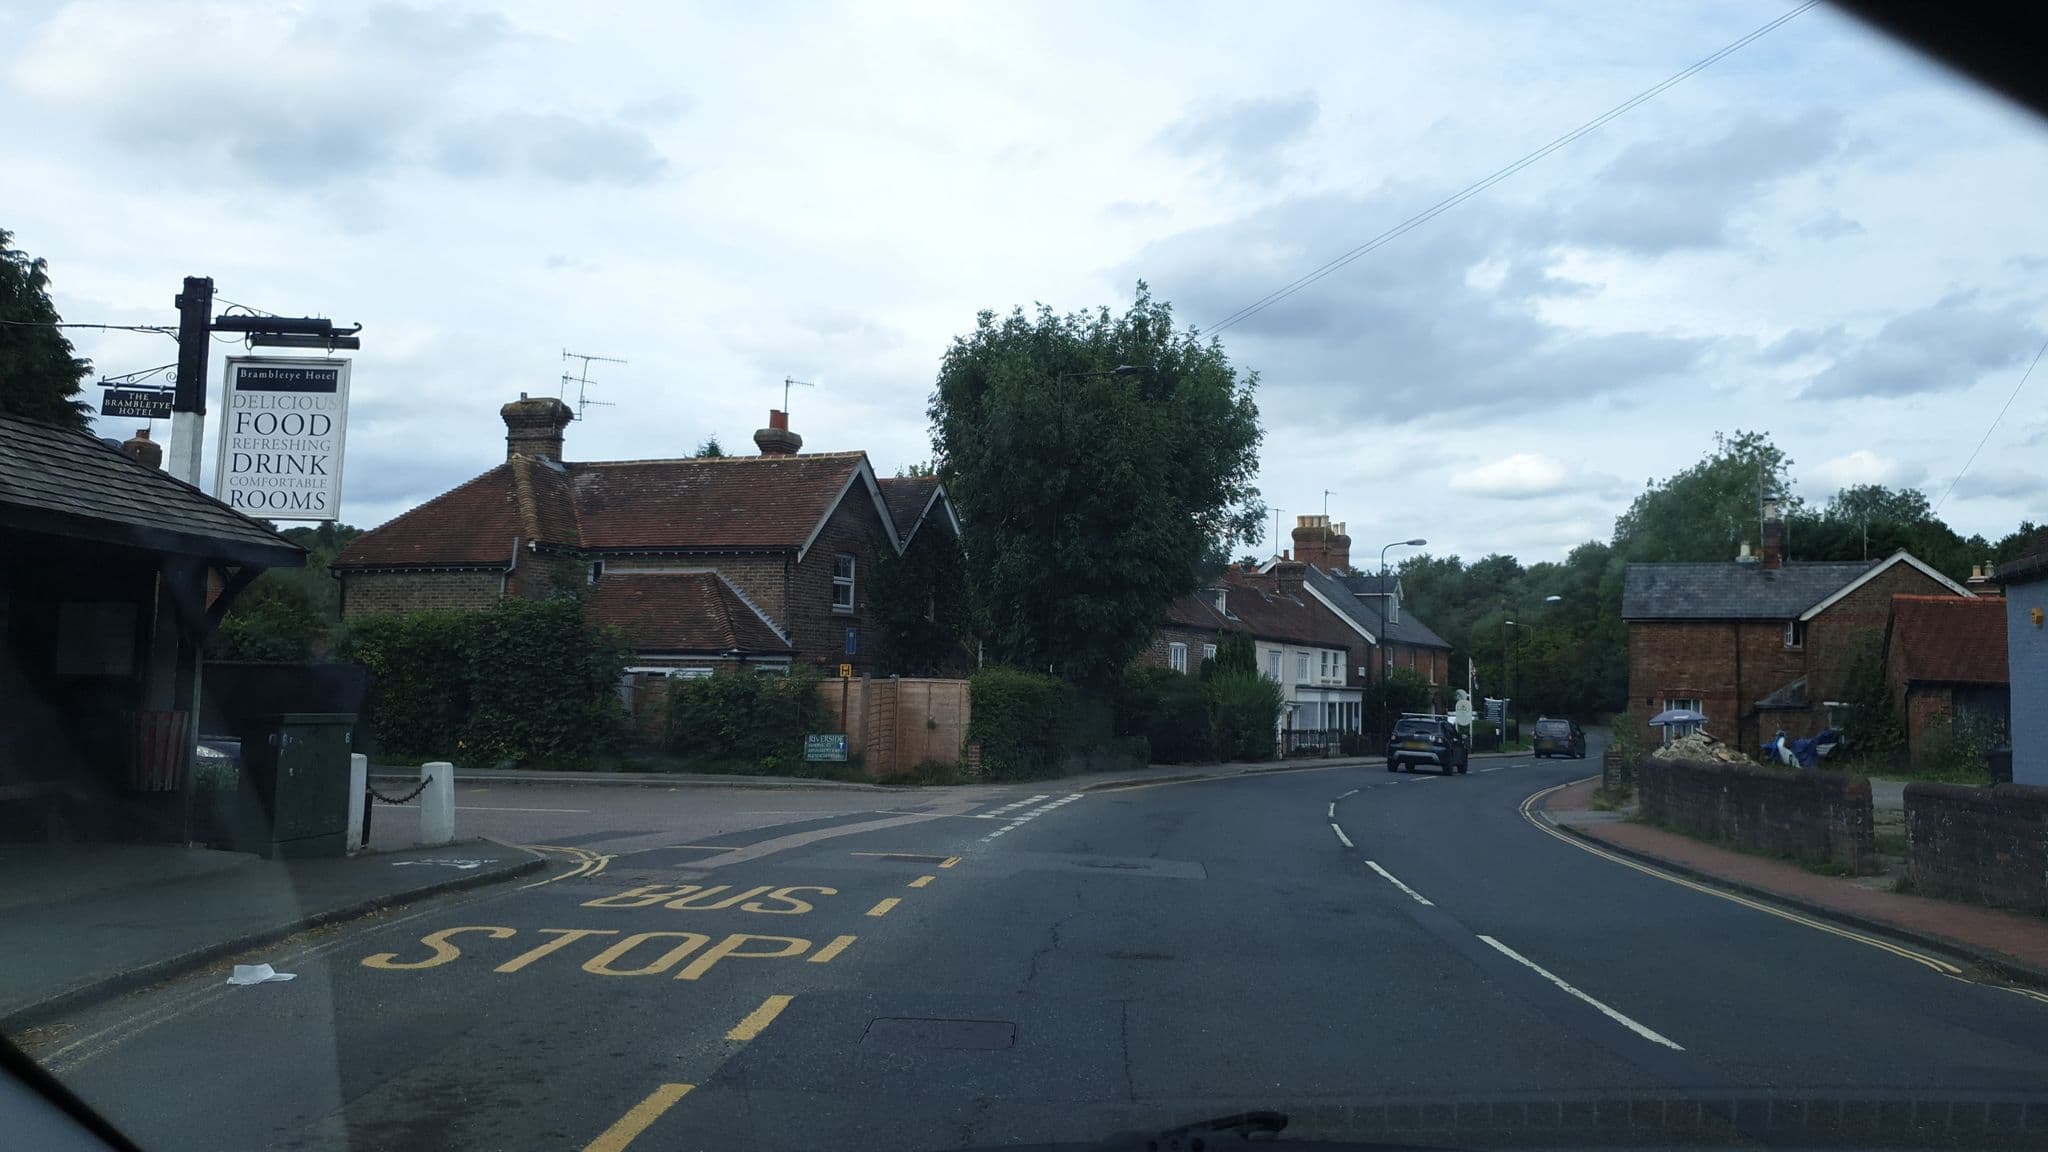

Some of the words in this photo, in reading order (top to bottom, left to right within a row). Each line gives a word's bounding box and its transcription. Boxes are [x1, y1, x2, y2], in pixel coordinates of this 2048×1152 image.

[240, 369, 301, 380] Brambletye
[305, 370, 335, 380] Hotel
[128, 392, 149, 400] THE
[104, 400, 171, 409] BRAMBLETYE
[118, 407, 153, 416] HOTEL
[235, 412, 331, 436] FOOD
[232, 437, 331, 452] REFRESHING
[231, 452, 329, 475] DRINK
[229, 476, 328, 489] COMFORTABLE
[230, 489, 326, 510] ROOMS
[841, 665, 850, 676] H
[808, 735, 845, 744] RIVERSIDE
[579, 885, 838, 914] BUS
[360, 926, 812, 980] STOP
